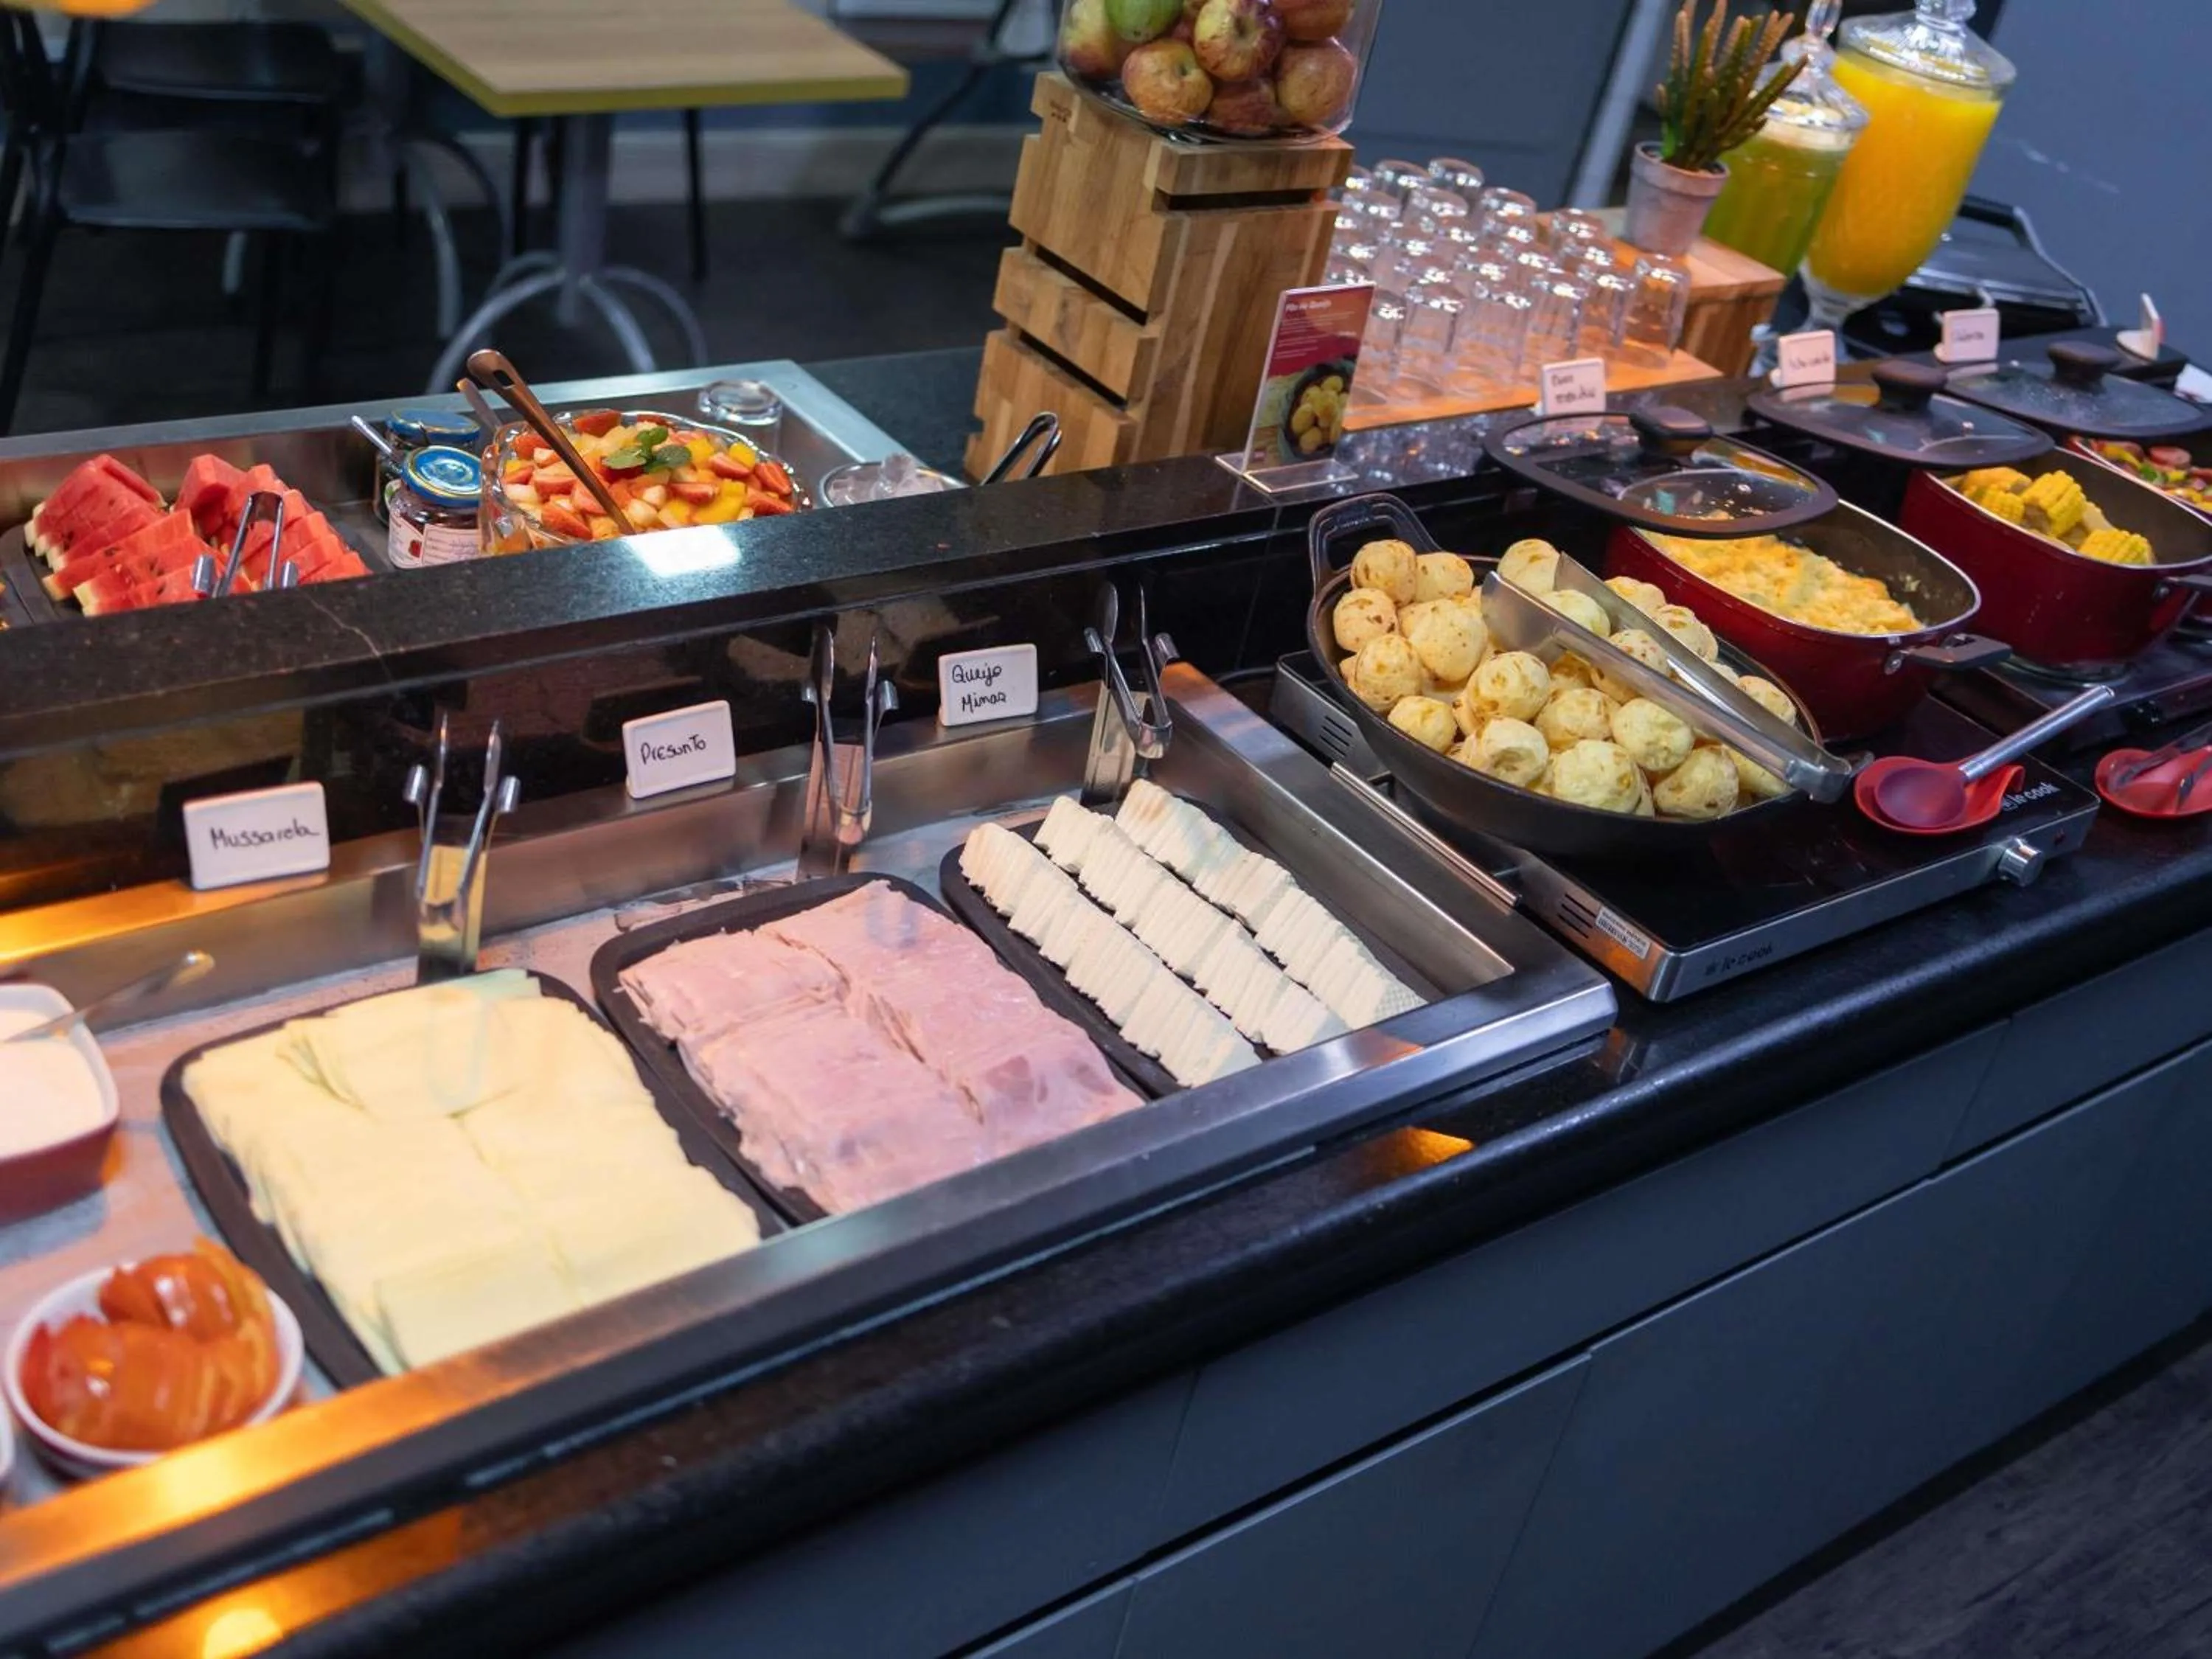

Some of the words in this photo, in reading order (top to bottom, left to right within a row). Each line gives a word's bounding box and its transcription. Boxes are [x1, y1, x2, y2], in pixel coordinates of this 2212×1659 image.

[951, 662, 1003, 686] Queijo
[961, 692, 1007, 714] Minas
[209, 817, 321, 850] Mussarela
